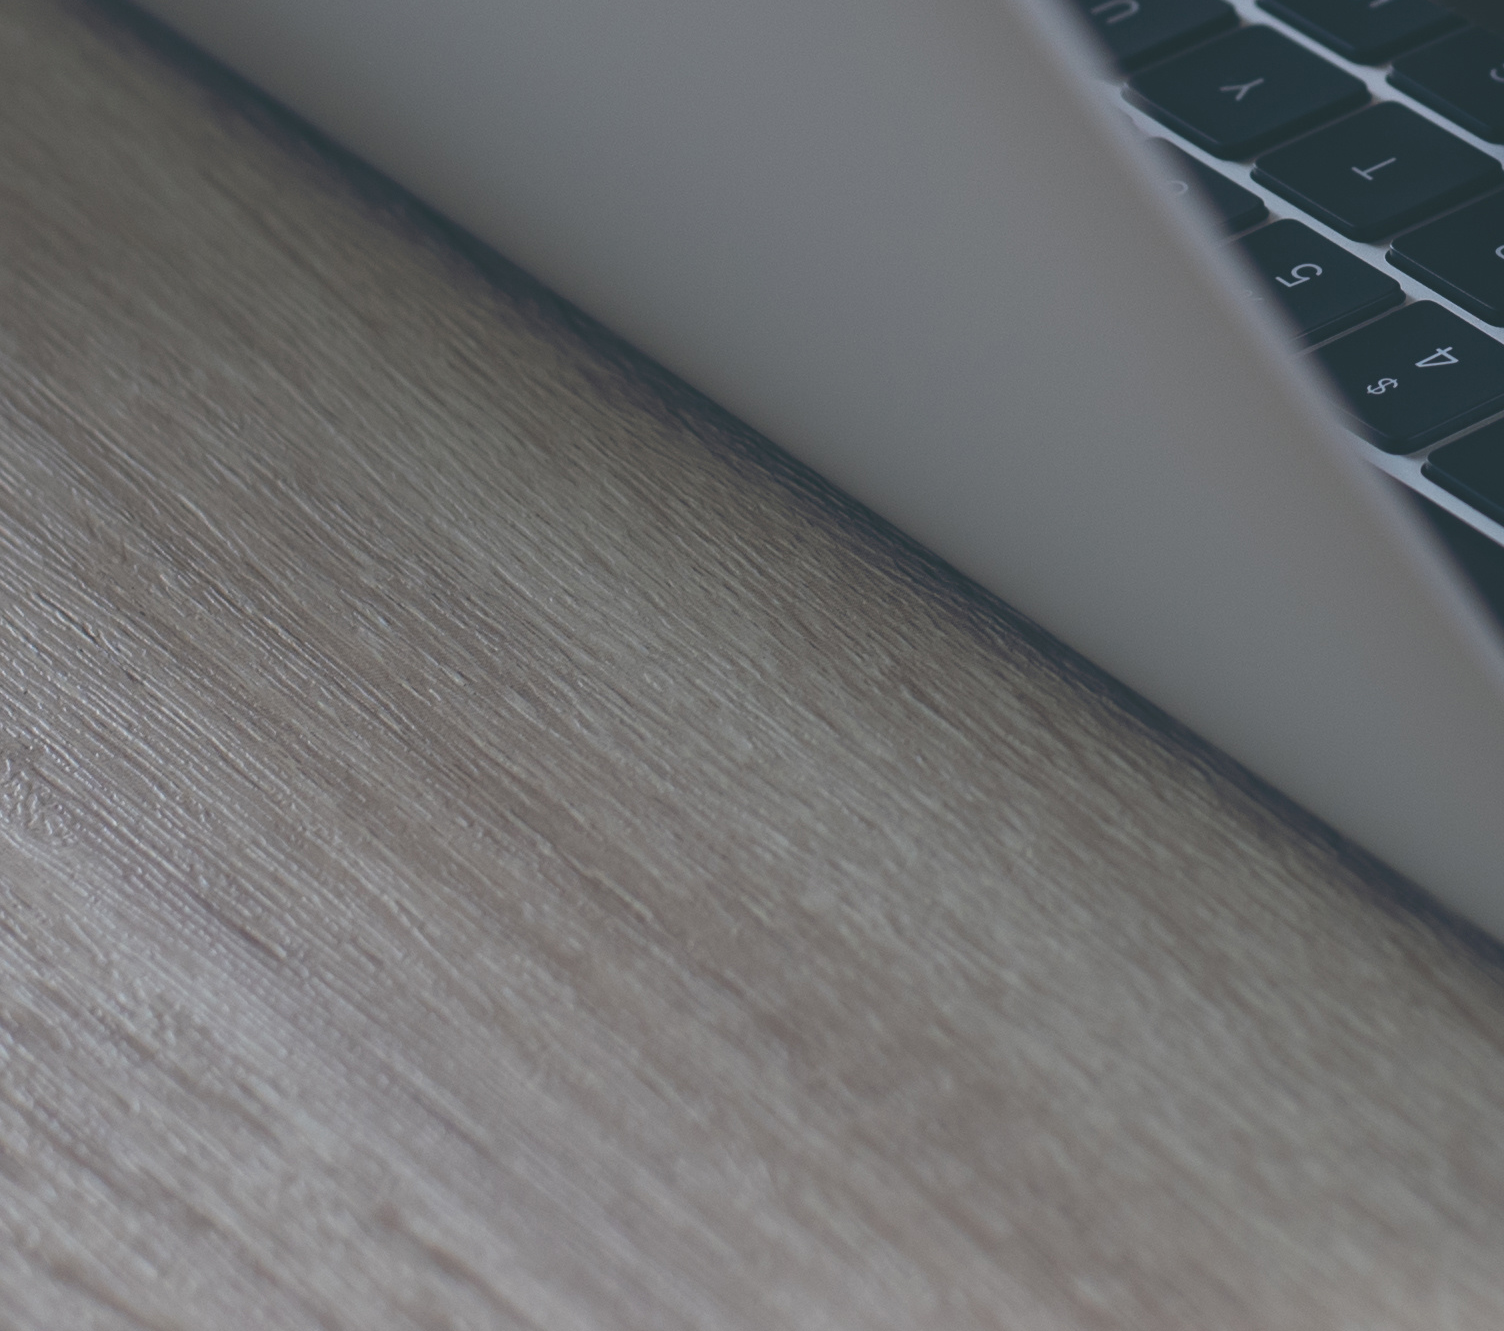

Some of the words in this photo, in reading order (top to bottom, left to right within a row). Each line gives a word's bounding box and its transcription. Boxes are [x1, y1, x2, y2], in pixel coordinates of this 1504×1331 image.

[1219, 77, 1265, 102] Y
[1352, 158, 1395, 180] T
[1276, 263, 1322, 287] 5
[1416, 347, 1458, 367] 4
[1367, 378, 1398, 394] $
